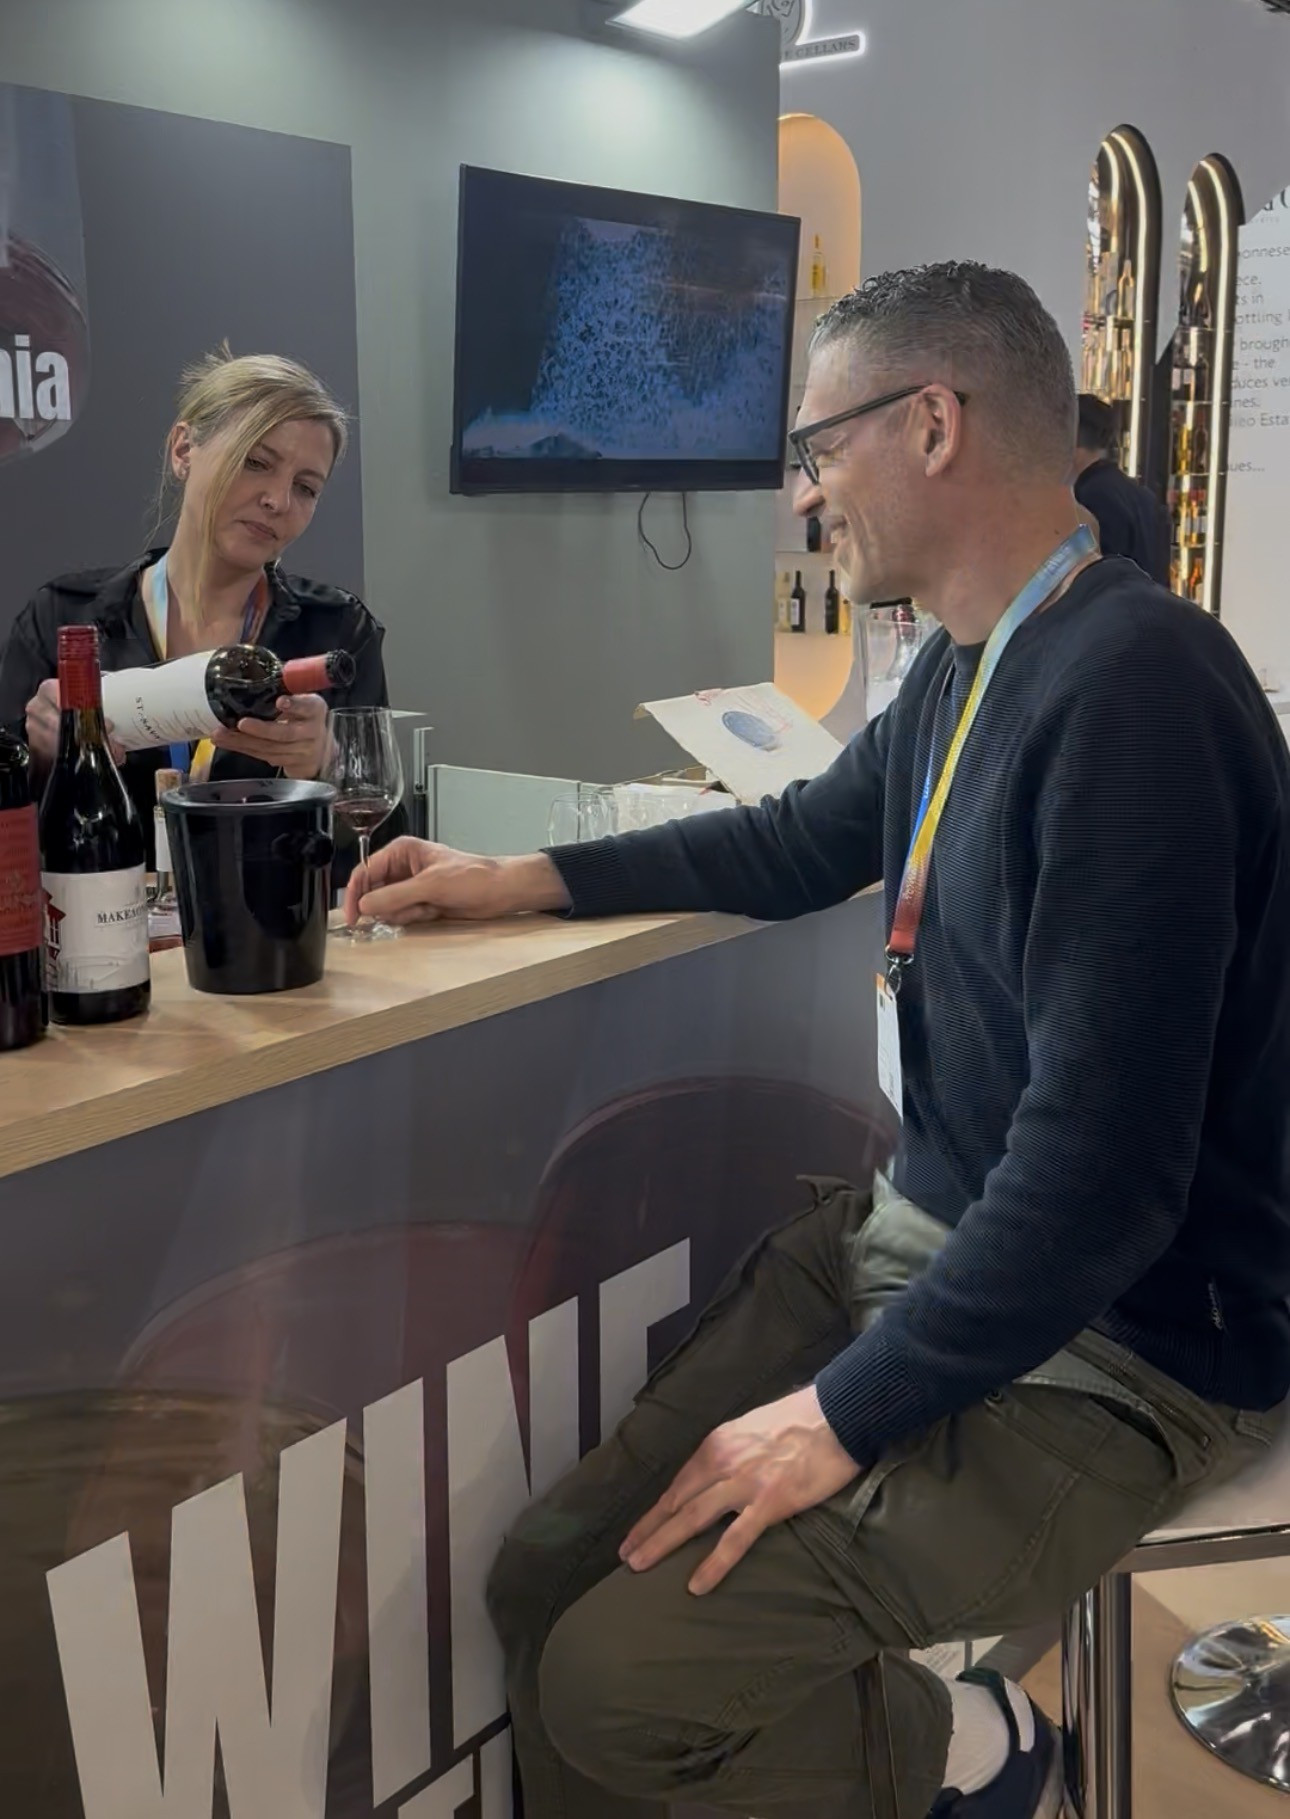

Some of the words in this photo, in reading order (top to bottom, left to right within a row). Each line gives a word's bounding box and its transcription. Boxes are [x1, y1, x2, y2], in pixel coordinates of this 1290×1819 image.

[795, 40, 856, 57] CELLARS
[1238, 246, 1290, 260] onnese
[1252, 293, 1264, 304] in
[1253, 356, 1276, 369] the
